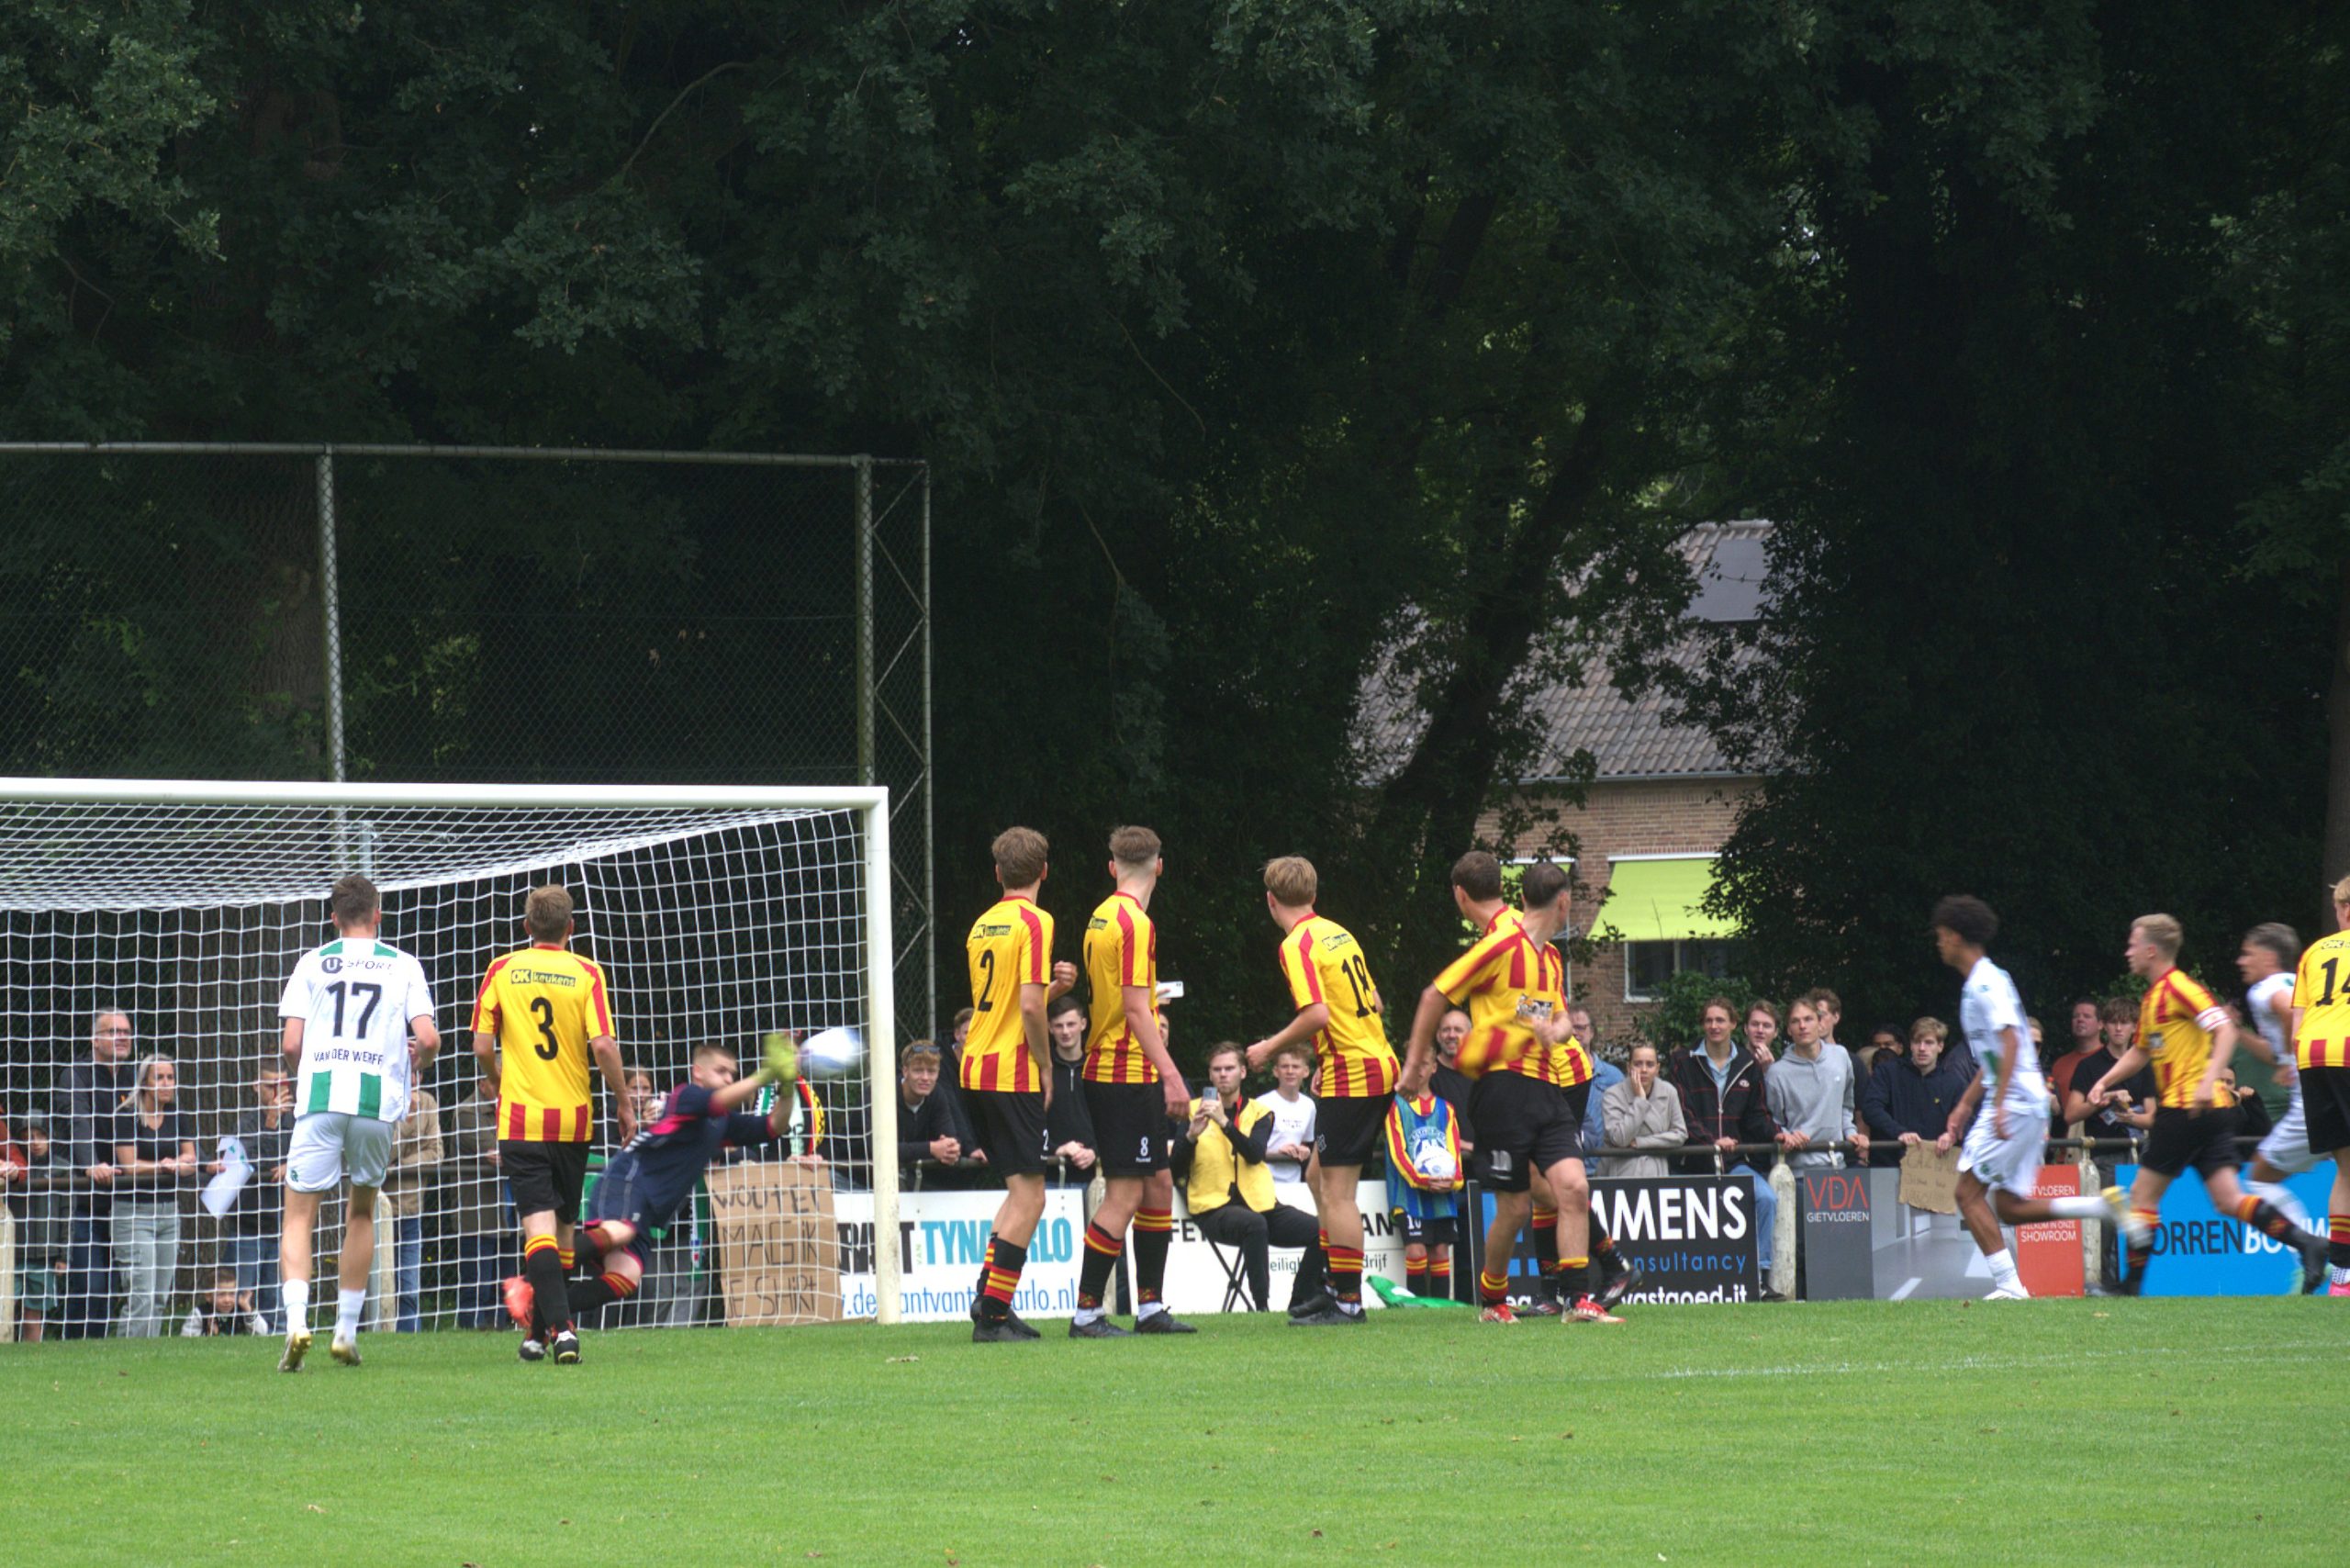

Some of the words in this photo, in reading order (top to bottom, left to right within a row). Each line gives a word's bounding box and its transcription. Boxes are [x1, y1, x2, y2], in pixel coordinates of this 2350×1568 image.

[511, 969, 532, 984] OK
[533, 971, 576, 987] keukens
[978, 949, 994, 1013] 2
[1341, 954, 1378, 1019] 18
[325, 980, 382, 1039] 17
[531, 997, 559, 1061] 3
[314, 1051, 330, 1062] VAN
[331, 1048, 349, 1061] DER
[1140, 1137, 1149, 1157] 8
[1807, 1175, 1869, 1210] VDA
[1807, 1212, 1870, 1223] GIETVLOEREN
[920, 1217, 1072, 1265] TYNLO
[2021, 1230, 2076, 1242] SHOWROOM
[1634, 1251, 1746, 1274] nsultancy
